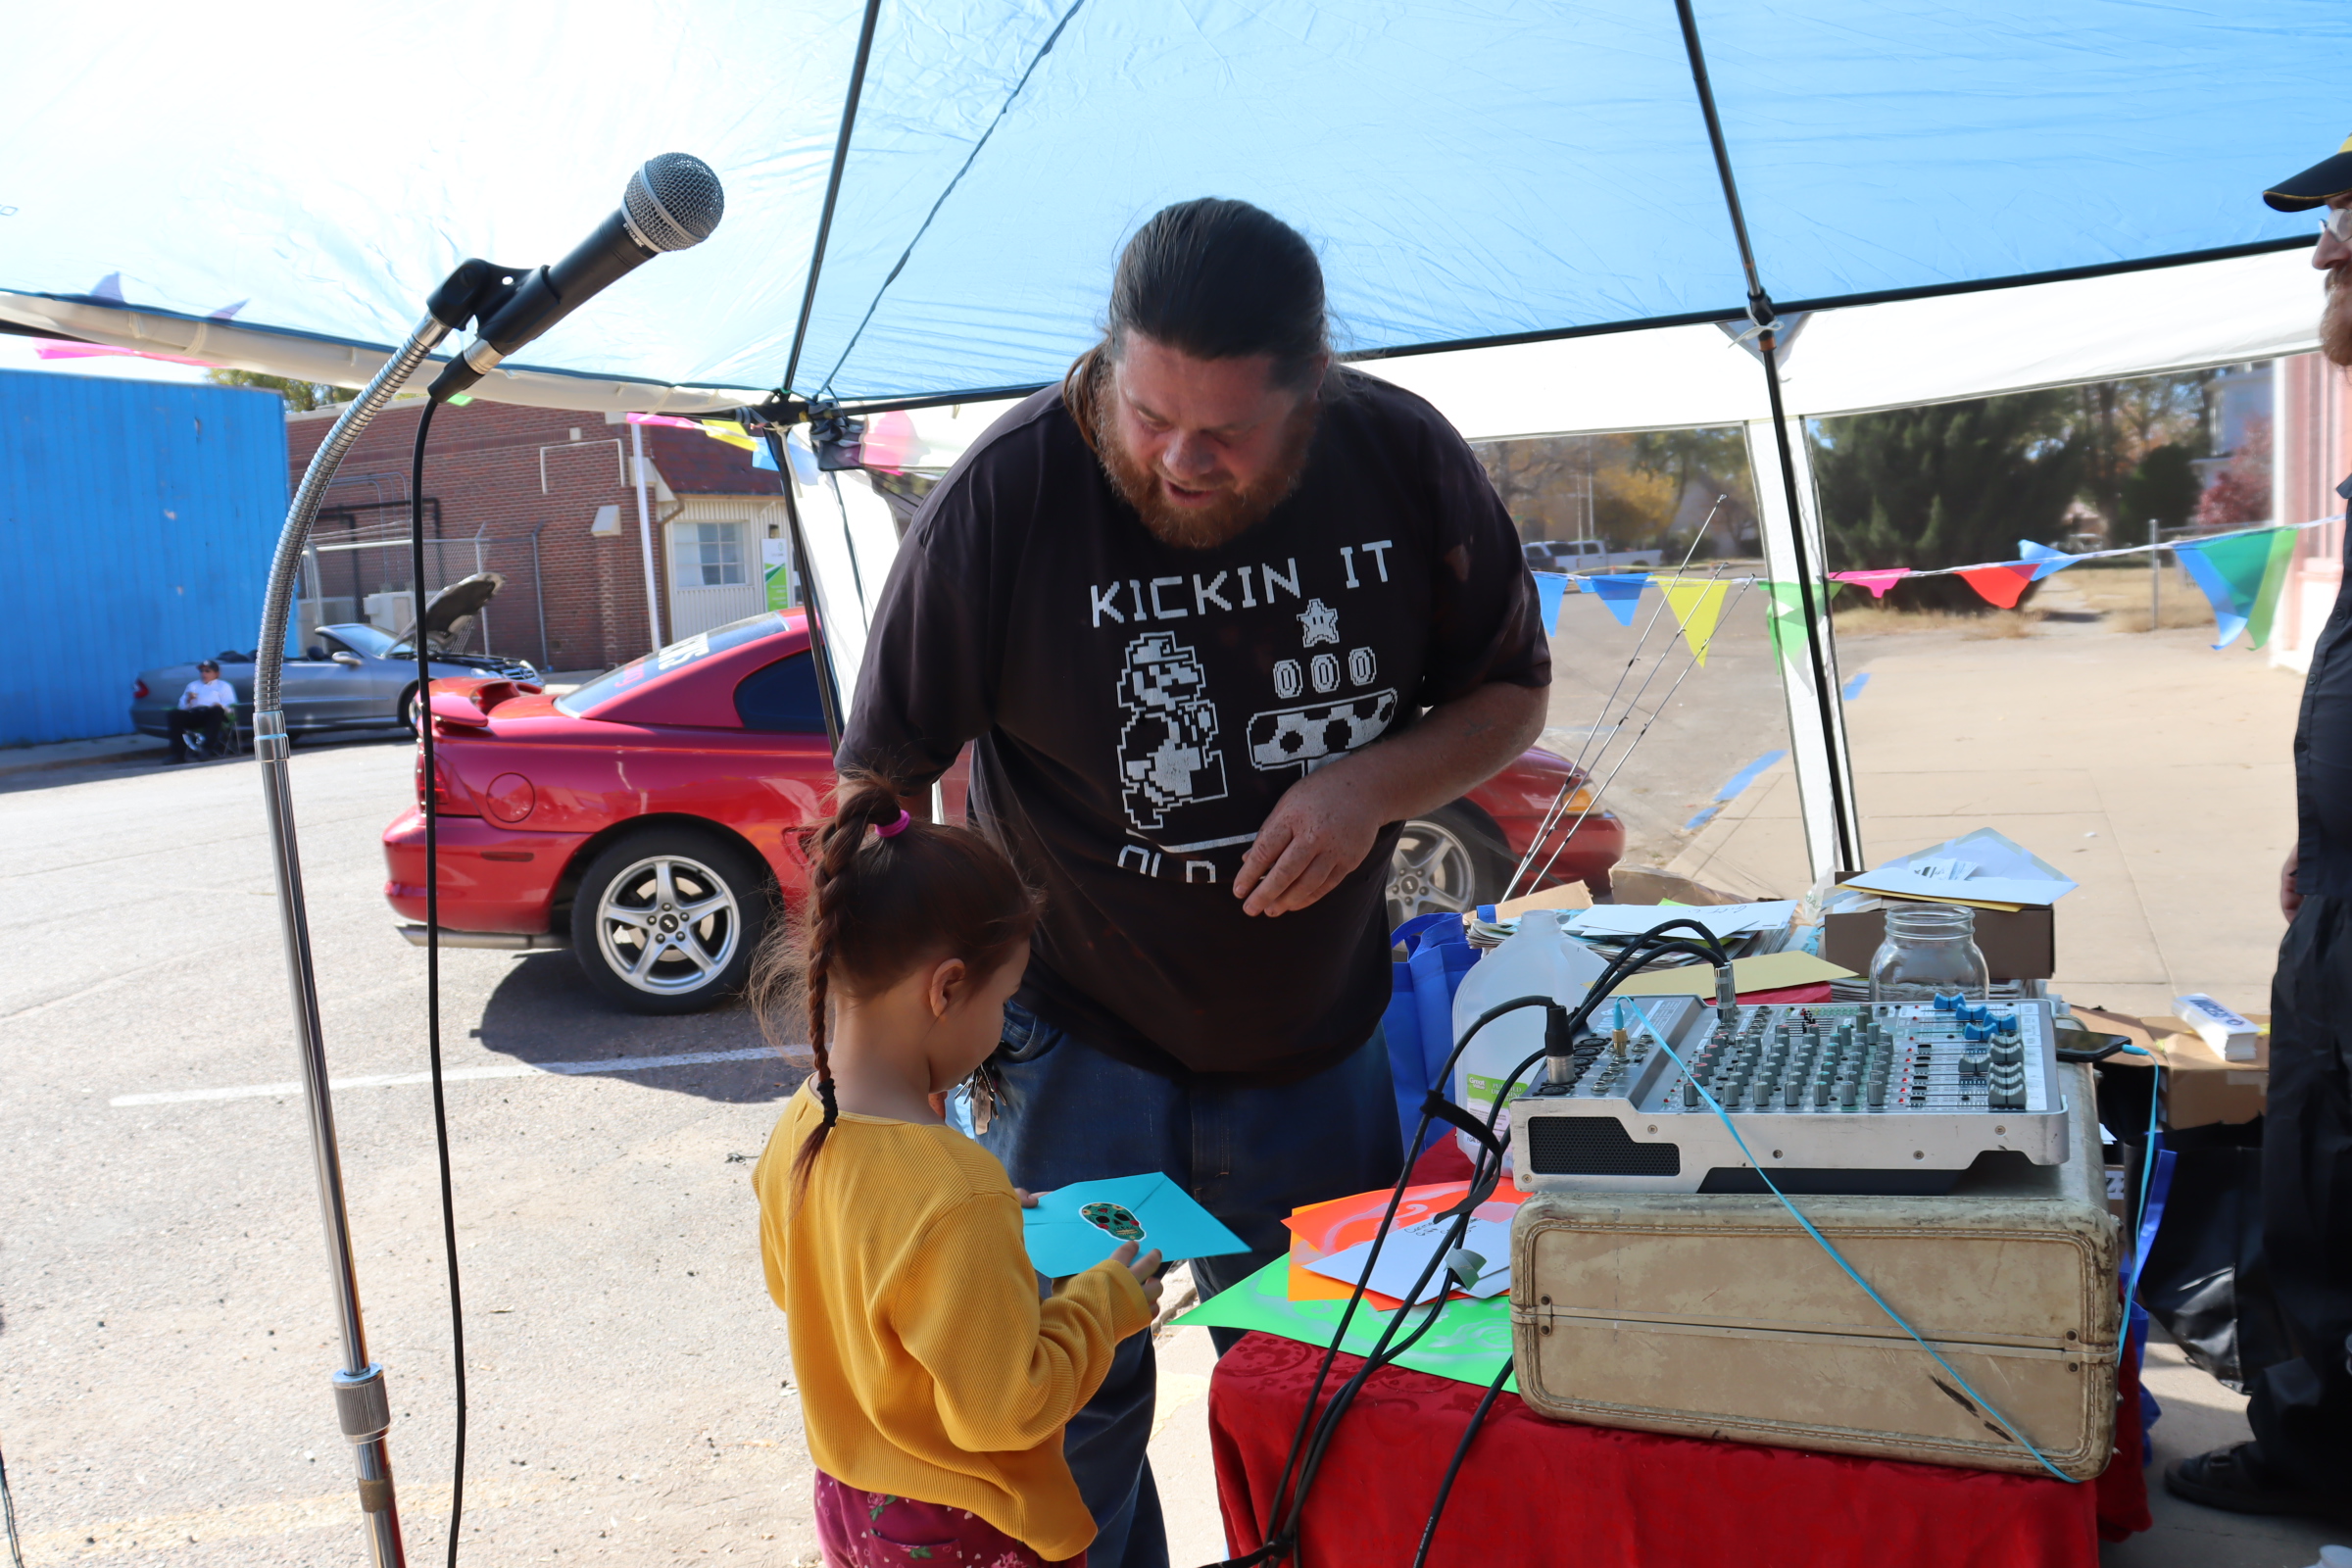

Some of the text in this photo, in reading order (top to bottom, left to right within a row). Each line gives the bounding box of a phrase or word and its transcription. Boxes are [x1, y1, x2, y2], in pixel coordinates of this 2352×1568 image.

[623, 222, 645, 247] DYNAMIC
[1090, 540, 1393, 627] KICKIN IT
[1469, 1077, 1486, 1087] Great
